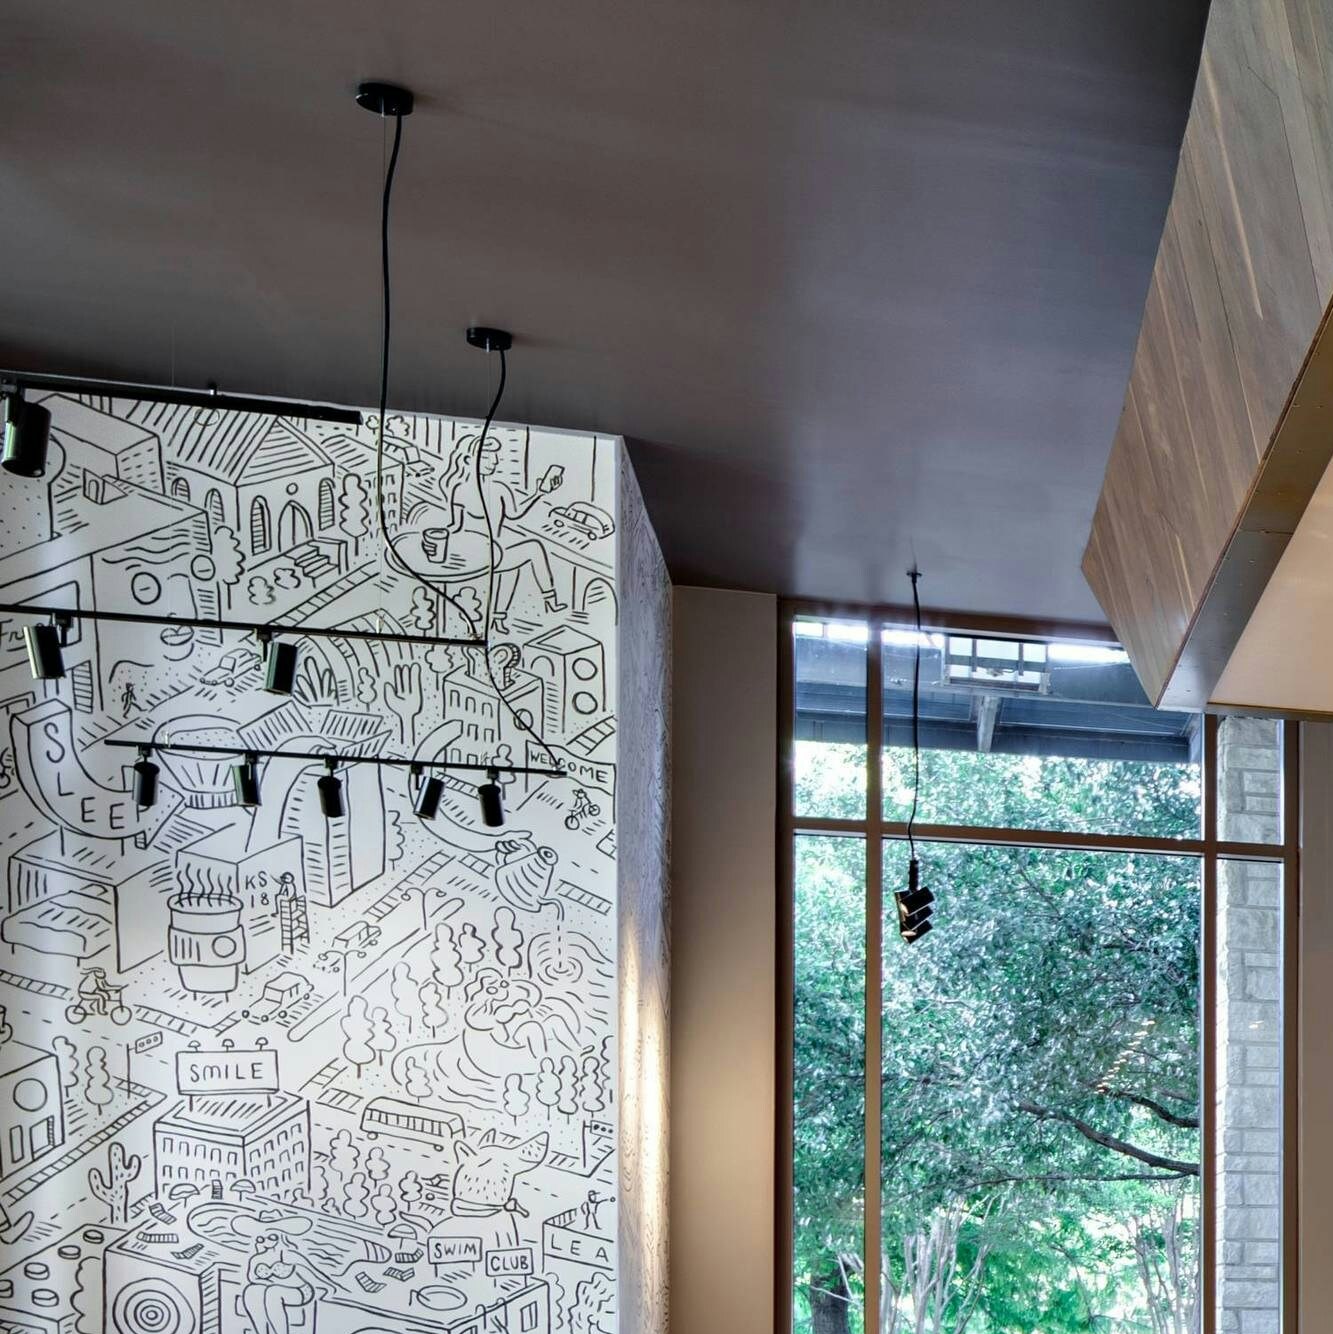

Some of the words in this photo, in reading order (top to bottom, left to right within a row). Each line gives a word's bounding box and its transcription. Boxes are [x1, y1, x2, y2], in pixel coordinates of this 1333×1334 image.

[190, 1062, 264, 1083] SMILE
[434, 1242, 477, 1259] SWIM
[490, 1255, 529, 1271] CLUB
